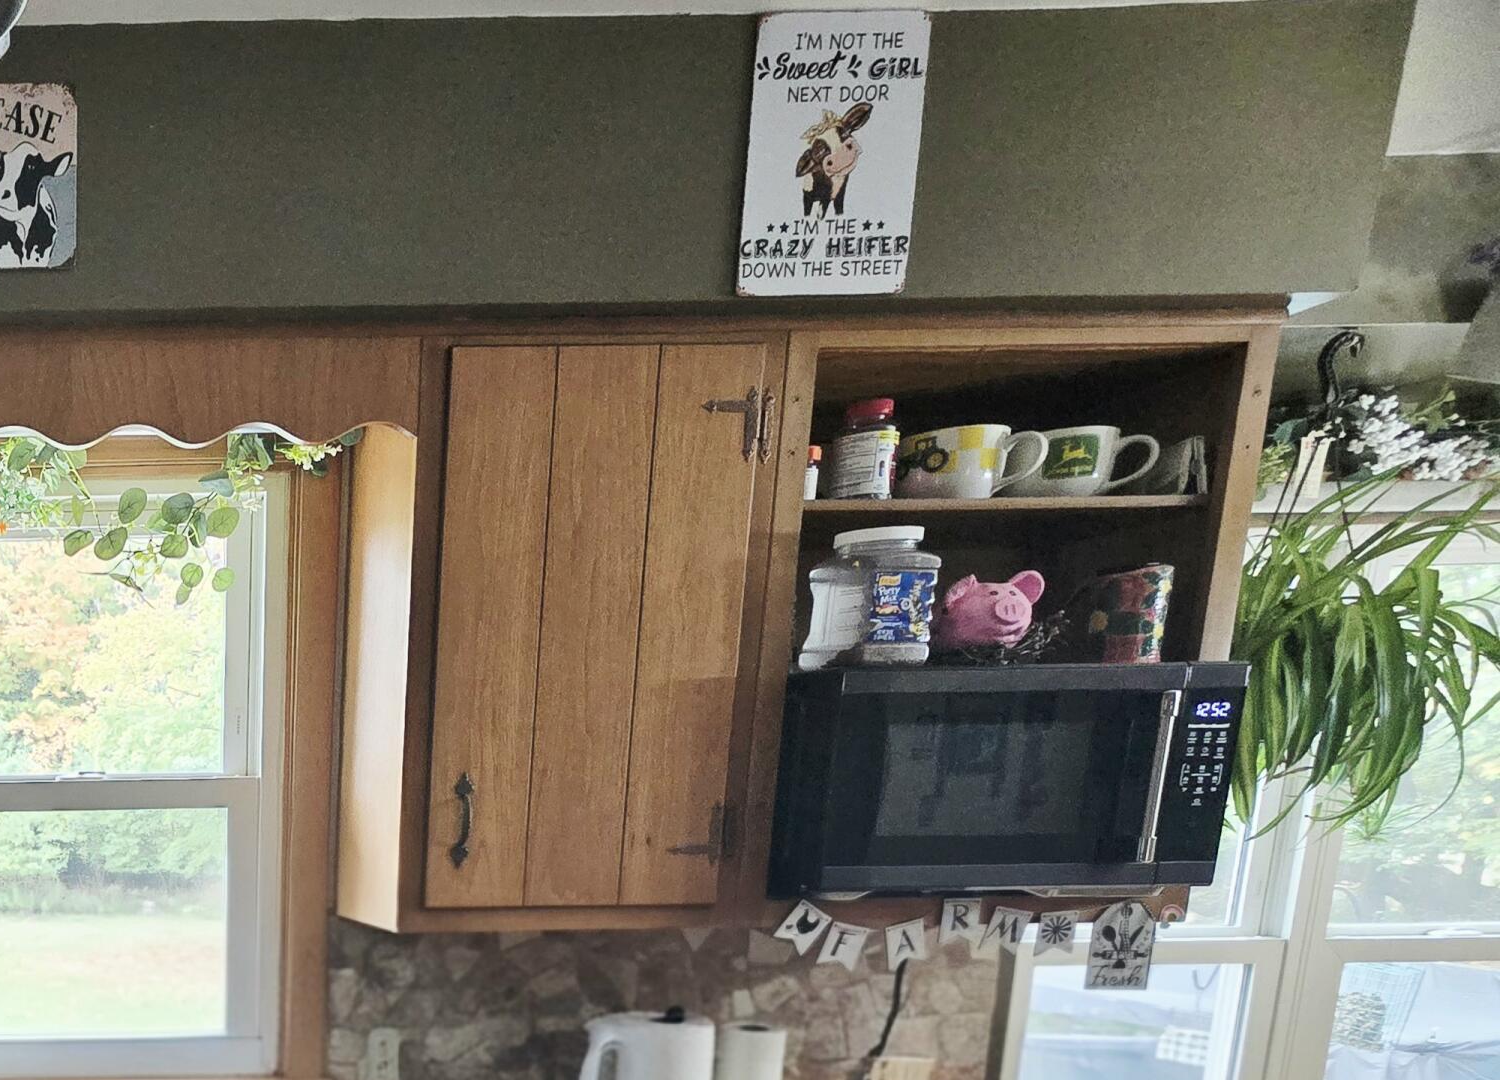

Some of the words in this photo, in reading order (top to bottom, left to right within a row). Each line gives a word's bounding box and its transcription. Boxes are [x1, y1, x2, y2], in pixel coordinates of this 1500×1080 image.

[795, 32, 822, 50] I'M
[829, 33, 867, 50] NOT
[873, 31, 905, 49] THE
[773, 50, 847, 80] Sweet
[787, 86, 833, 103] NEXT
[840, 84, 890, 102] DOOR
[792, 219, 820, 236] I'M
[825, 219, 857, 235] THE
[740, 238, 815, 260] CRAZY
[825, 235, 909, 258] HEIFER
[742, 263, 796, 278] DOWN
[802, 261, 833, 277] THE
[840, 259, 903, 276] STREET
